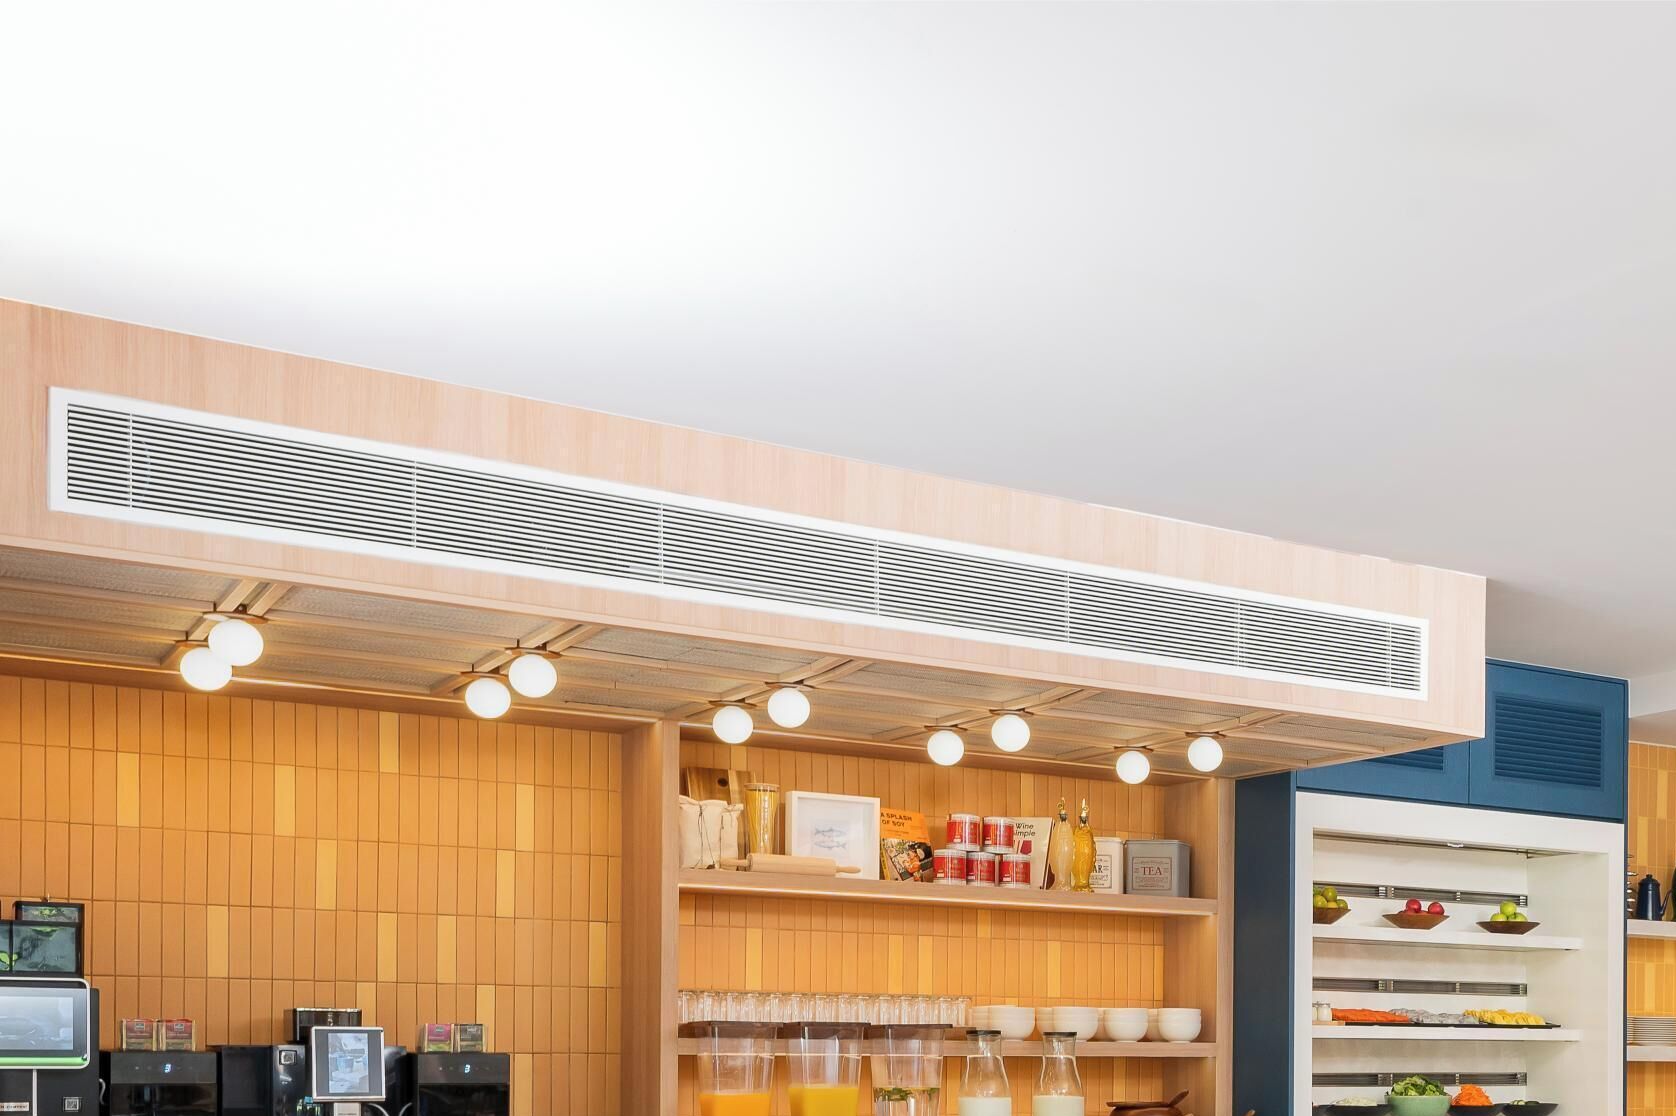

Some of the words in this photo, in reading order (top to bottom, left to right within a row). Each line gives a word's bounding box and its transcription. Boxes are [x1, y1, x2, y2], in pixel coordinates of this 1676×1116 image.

[886, 813, 912, 822] SPLASH
[1015, 822, 1034, 830] Wine
[1014, 829, 1036, 839] imple
[1140, 866, 1162, 876] TEA
